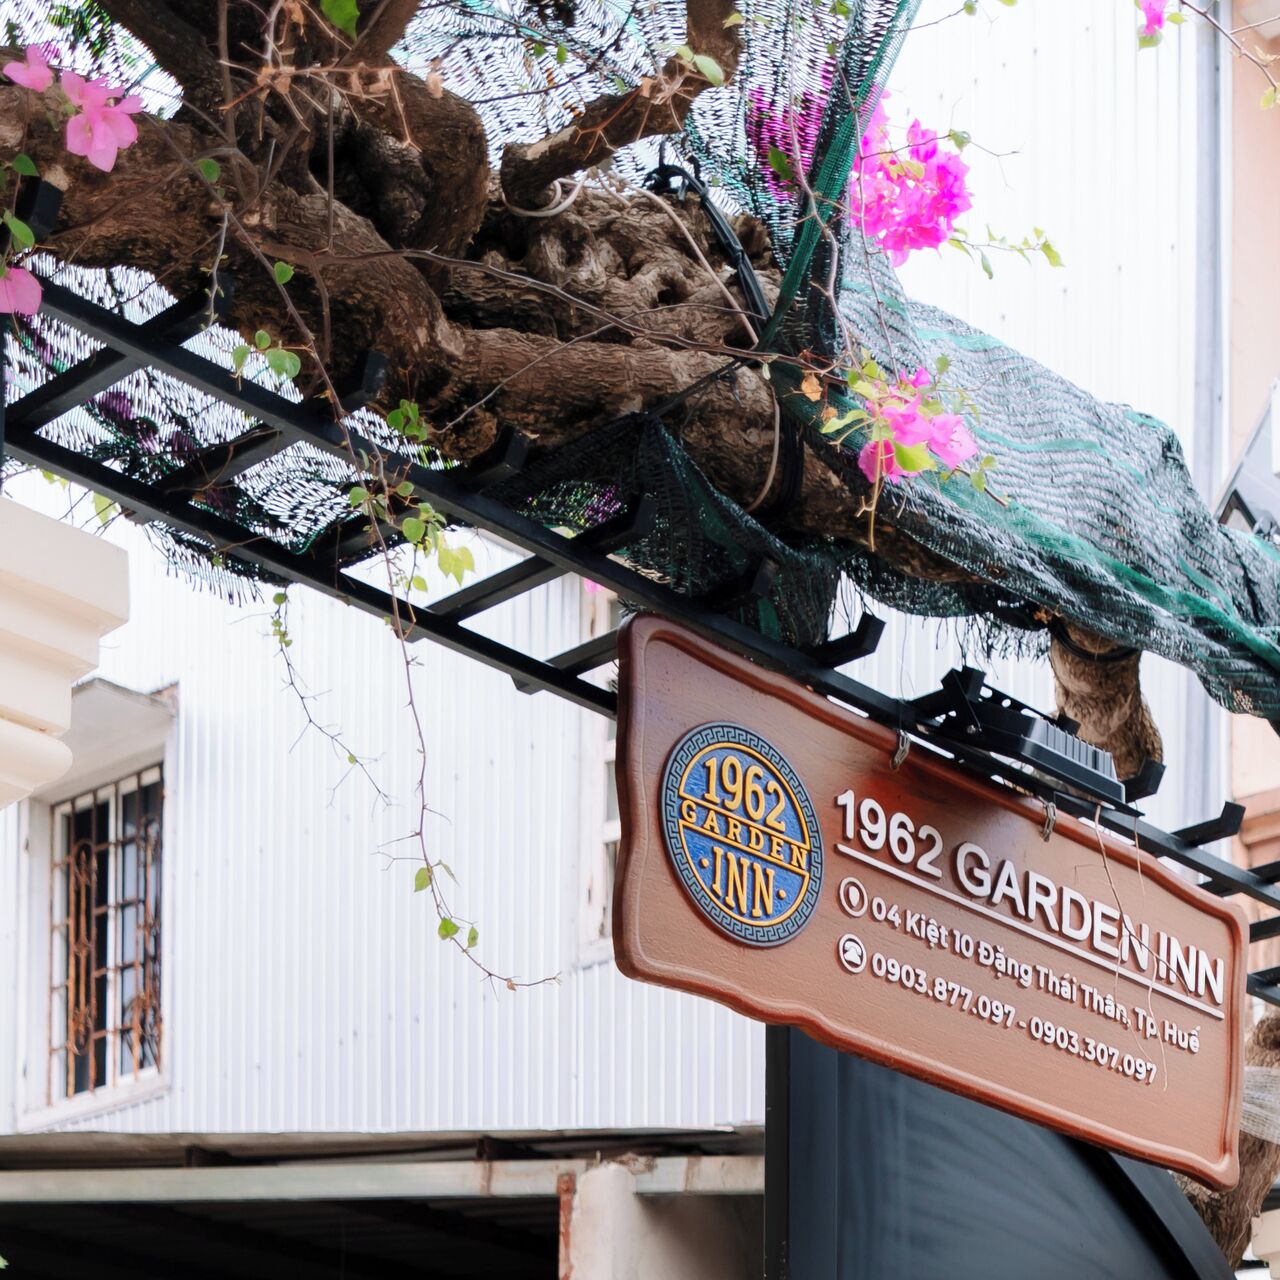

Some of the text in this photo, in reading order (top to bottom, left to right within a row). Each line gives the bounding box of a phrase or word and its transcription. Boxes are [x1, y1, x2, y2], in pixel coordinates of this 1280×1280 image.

[681, 799, 808, 870] GARDEN
[703, 755, 785, 833] 1962
[711, 846, 775, 918] INN
[837, 789, 1224, 1005] 1962 GARDEN INN
[872, 897, 901, 928] 04
[906, 910, 949, 950] Kiệt
[953, 930, 974, 959] 10
[978, 941, 1033, 988] Đặng
[1036, 964, 1077, 1003] Thái
[1164, 1020, 1201, 1053] Huế
[872, 952, 1016, 1028] 0903.877.097
[1030, 1016, 1157, 1084] 0903.307.097
